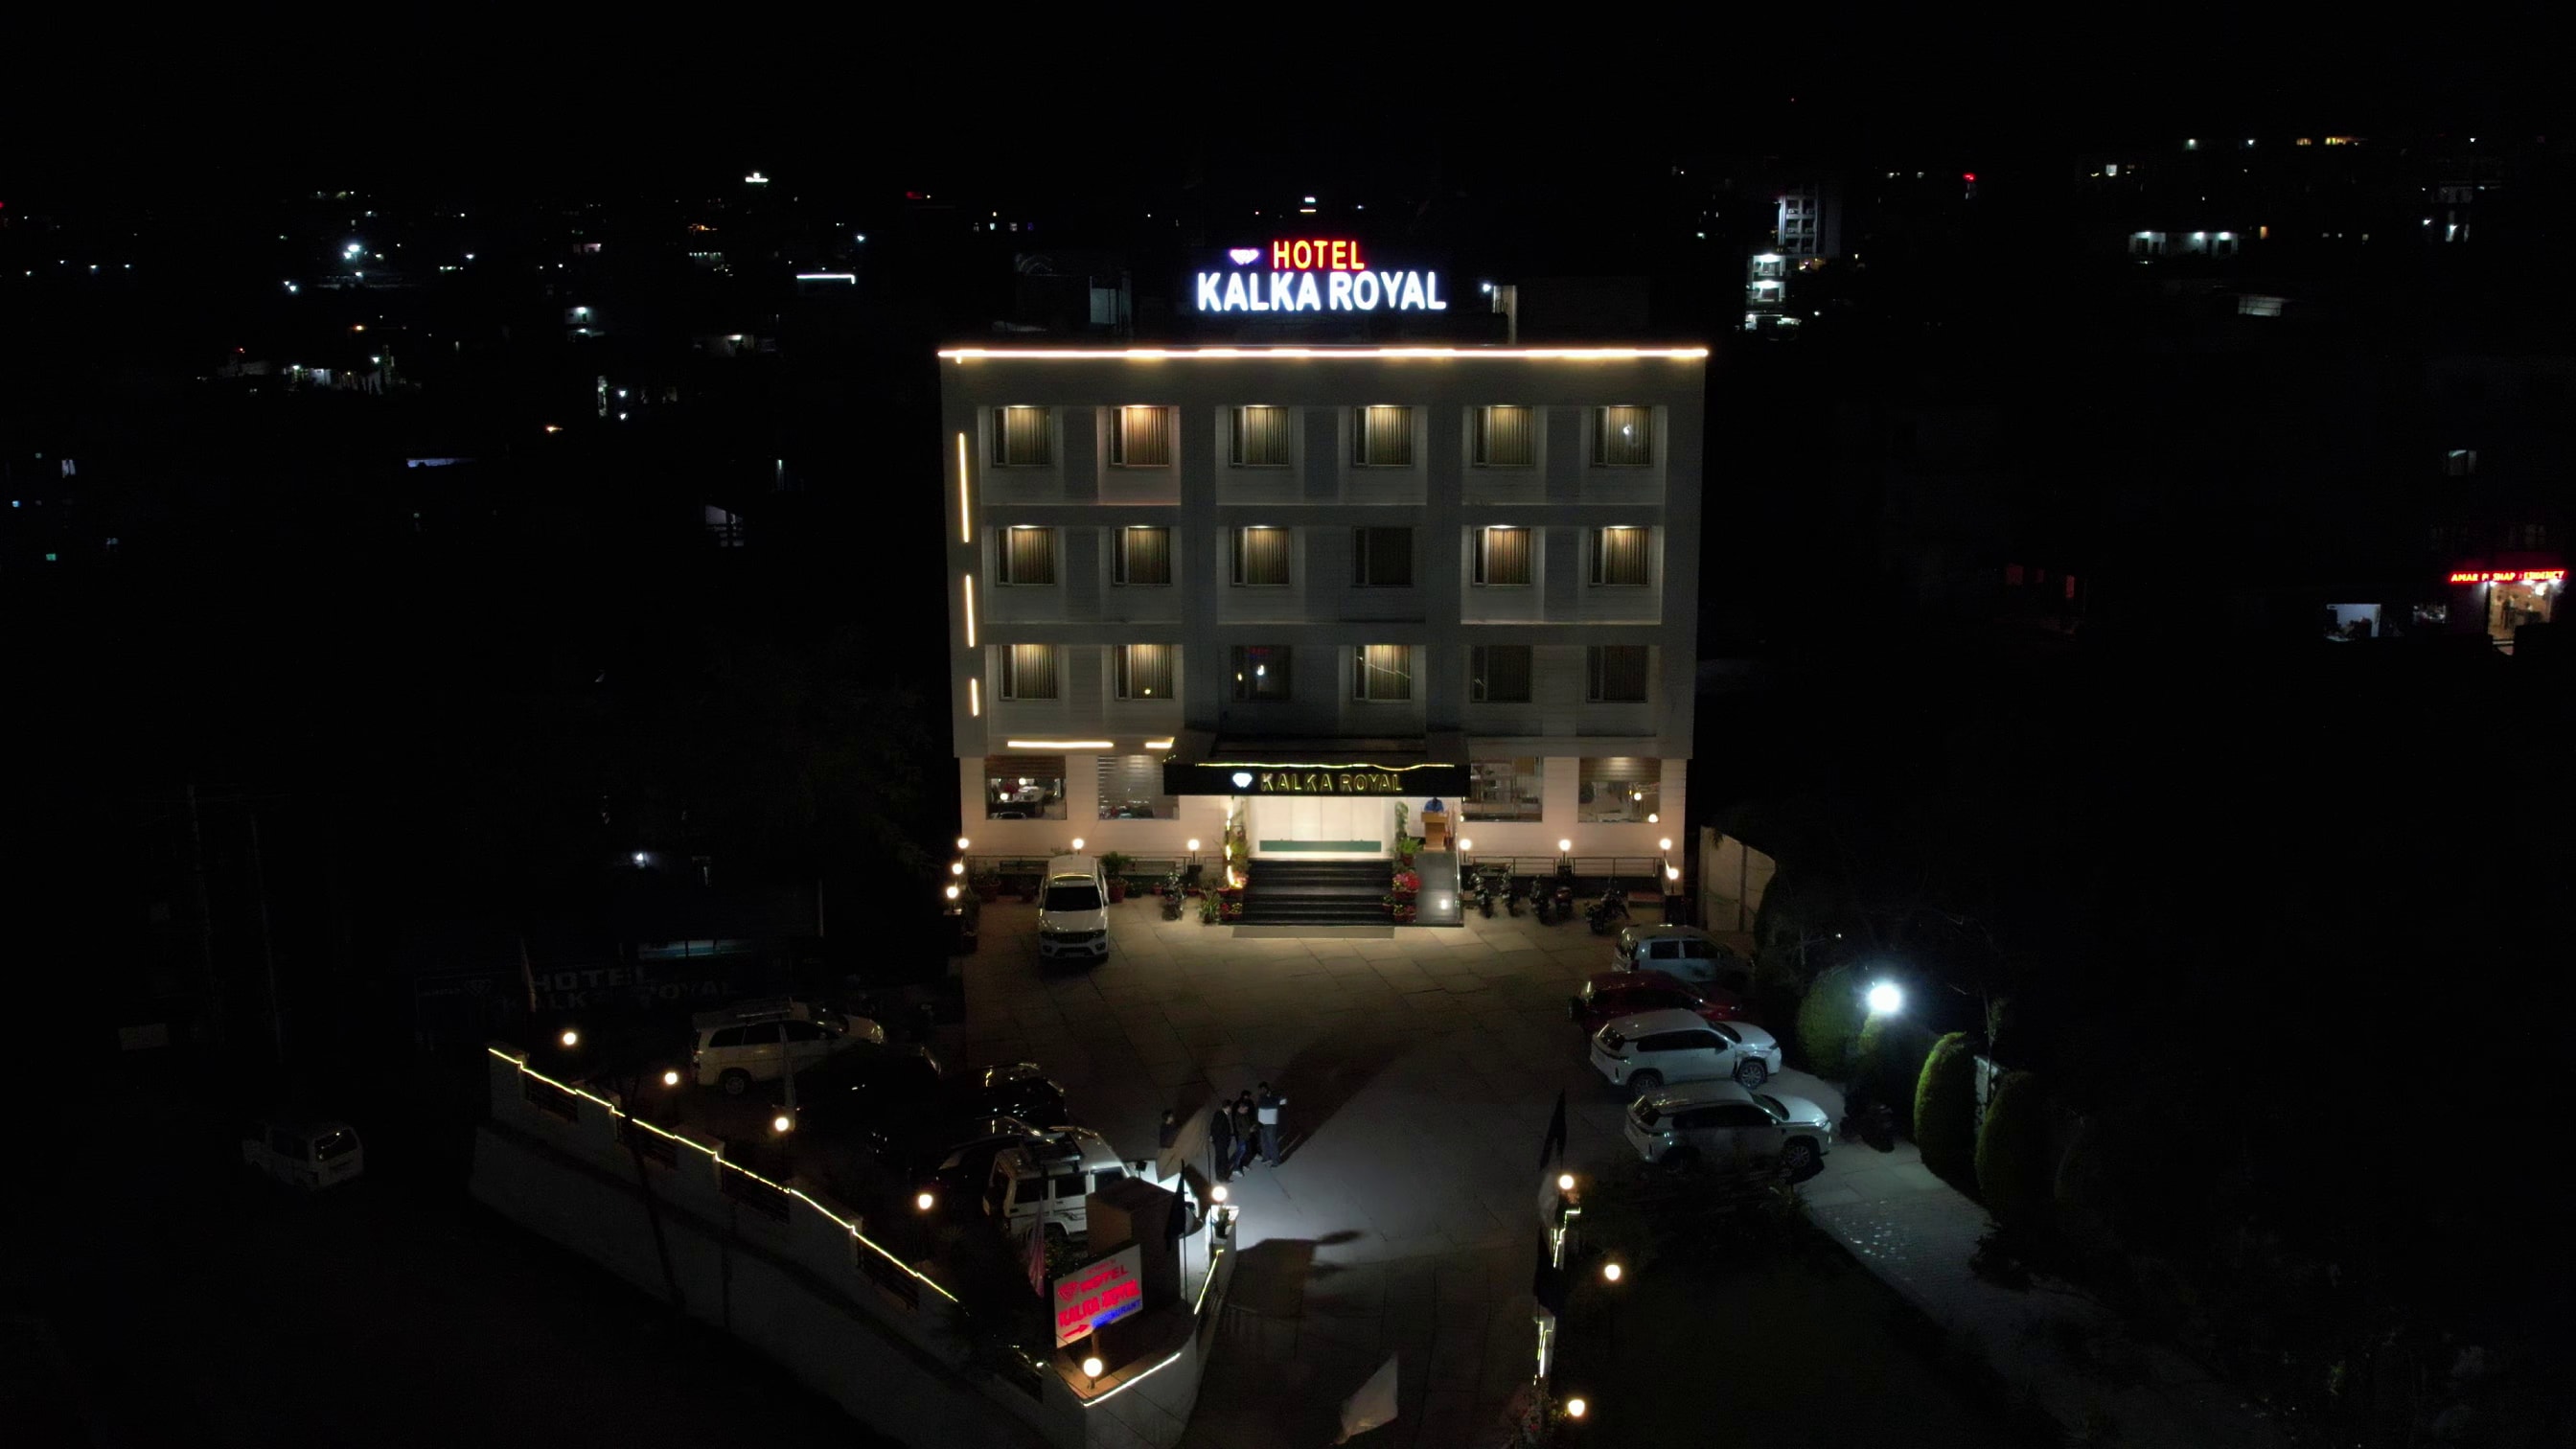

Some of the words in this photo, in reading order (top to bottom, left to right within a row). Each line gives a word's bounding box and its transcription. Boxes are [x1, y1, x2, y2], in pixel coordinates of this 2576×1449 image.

[1273, 241, 1365, 269] HOTEL
[1197, 272, 1322, 311] KALKA
[1328, 270, 1447, 310] ROYAL
[1260, 772, 1333, 792] KALKA
[1341, 772, 1403, 792] ROYAL
